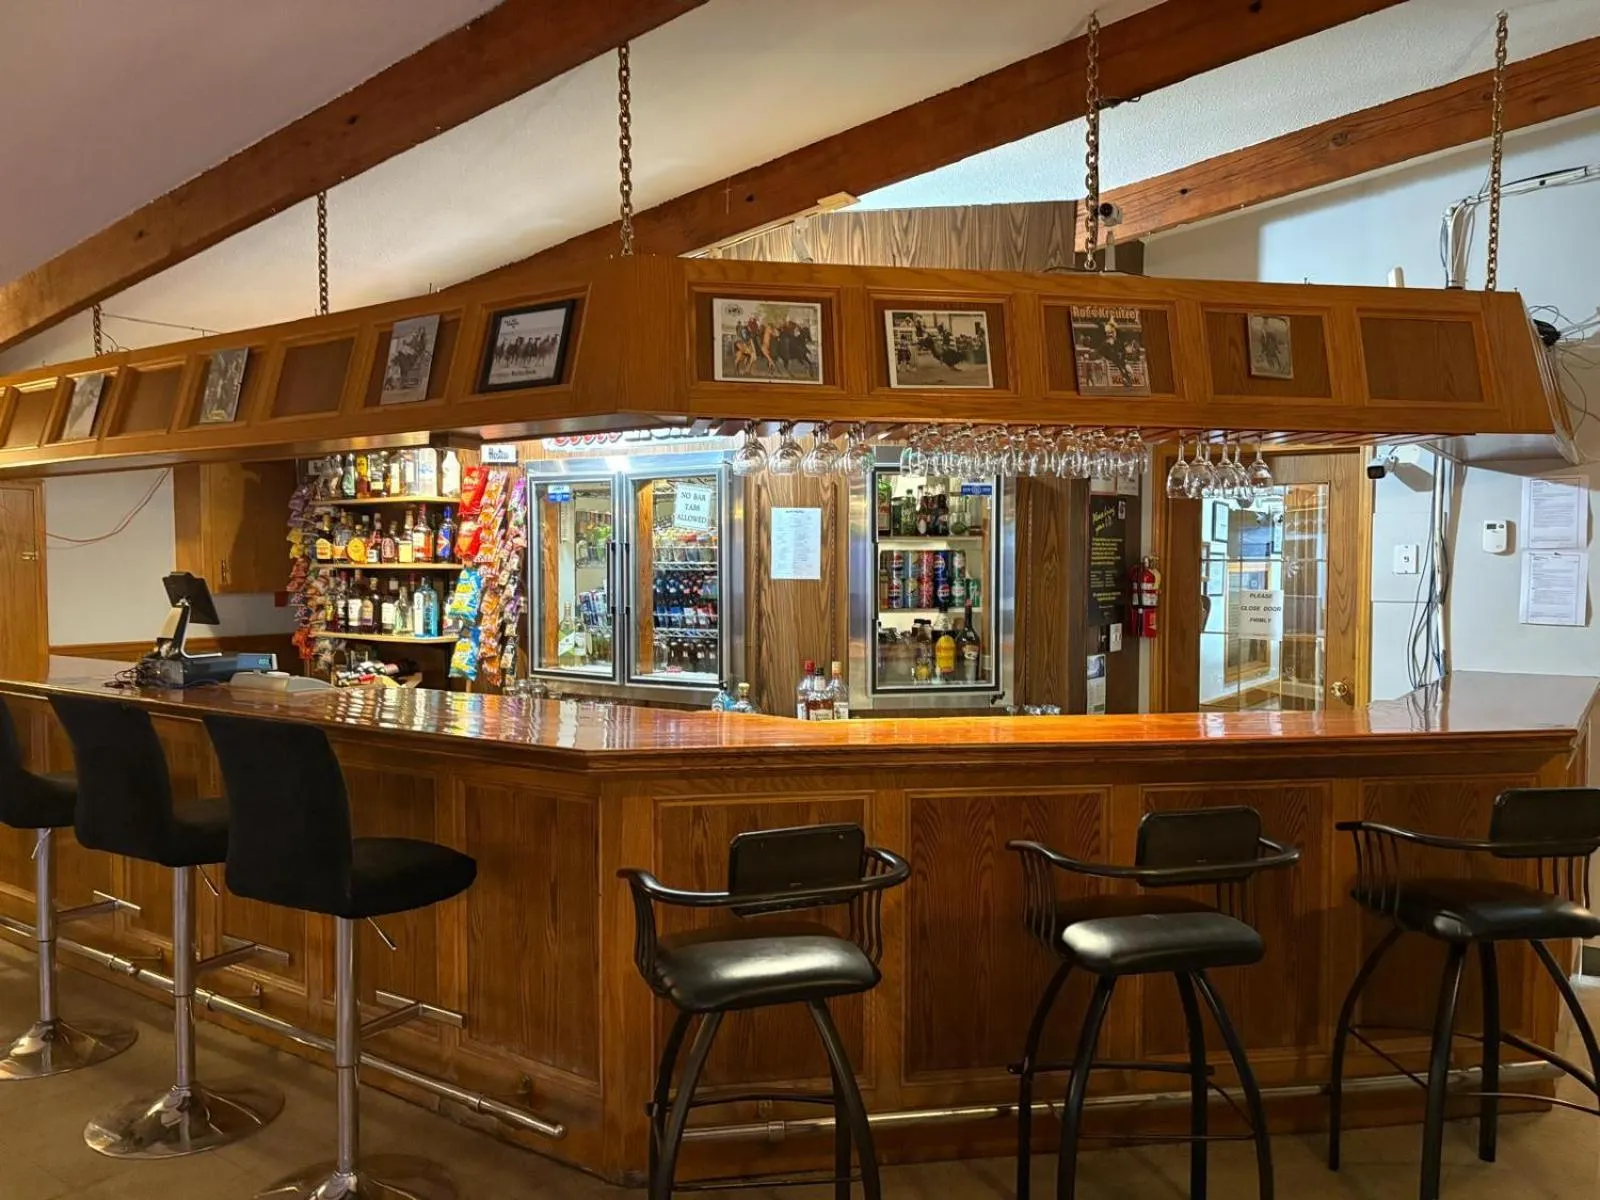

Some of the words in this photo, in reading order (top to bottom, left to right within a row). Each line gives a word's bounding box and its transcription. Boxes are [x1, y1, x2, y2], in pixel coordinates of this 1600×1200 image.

[680, 491, 691, 499] NO
[693, 493, 706, 501] BAR
[684, 503, 700, 511] TABS
[677, 514, 707, 524] ALLOWED
